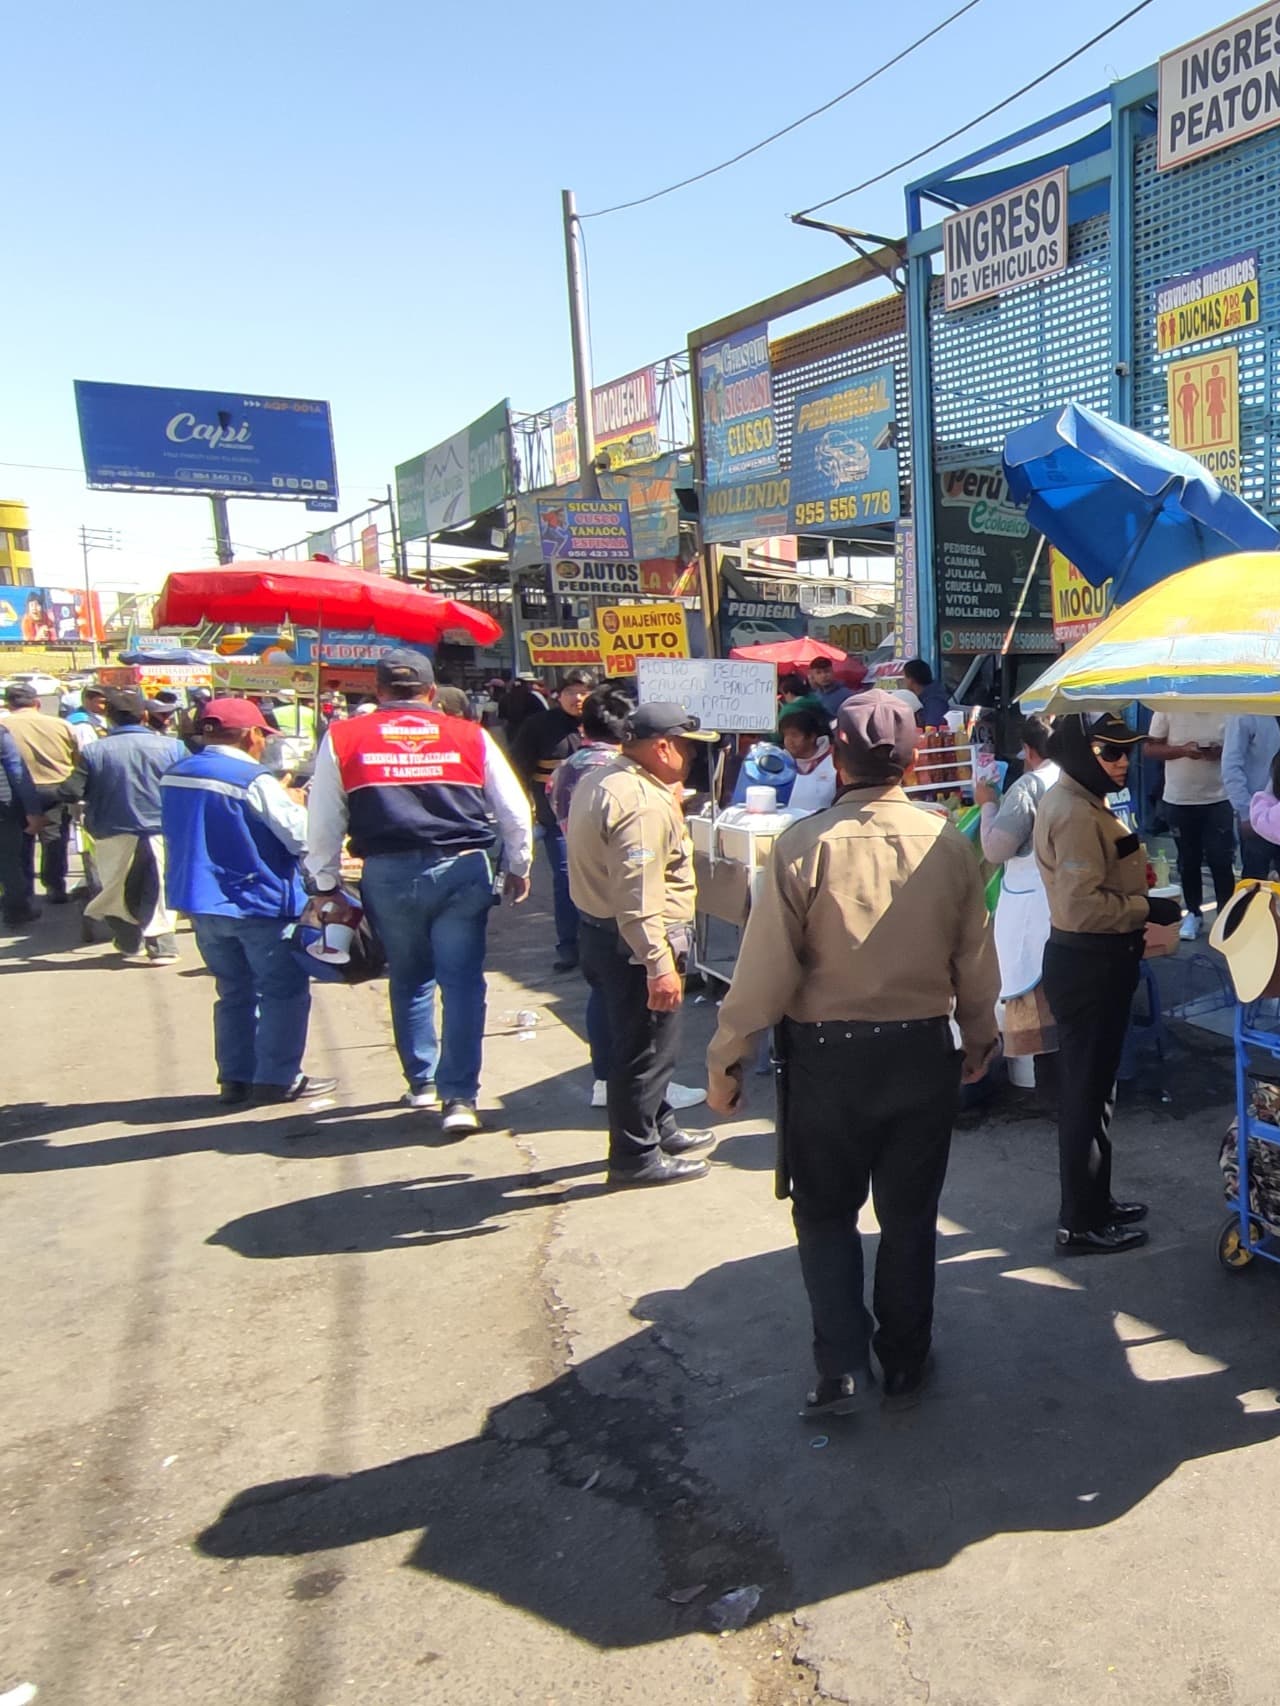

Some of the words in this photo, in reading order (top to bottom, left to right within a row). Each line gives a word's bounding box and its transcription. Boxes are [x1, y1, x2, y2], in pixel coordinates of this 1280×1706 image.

[948, 180, 1062, 272] INGRESO
[950, 277, 969, 301] DE
[974, 240, 1059, 292] VEHICULOS
[1158, 278, 1202, 314] SERVICIOS
[1202, 258, 1256, 297] HIGIENICOS
[1179, 298, 1222, 341] DUCHAS
[593, 375, 649, 436] MOQUEGUA
[797, 377, 890, 433] PEDREGAL
[166, 412, 253, 449] Capi
[727, 415, 773, 457] CUSCO
[706, 478, 791, 517] MOLLENDO
[568, 502, 623, 513] SICUANI
[795, 501, 825, 525] 955
[829, 495, 857, 521] 556
[862, 490, 891, 516] 778
[575, 514, 619, 525] CUSCO
[570, 526, 627, 536] YANAOCA
[610, 550, 630, 558] 333
[943, 542, 986, 556] PEDREGAL
[583, 562, 638, 581] AUTOS
[944, 569, 987, 580] JULIACA
[558, 580, 639, 594] PEDREGAL
[973, 583, 983, 593] LA
[946, 595, 979, 605] VITOR
[1059, 585, 1104, 618] MOQU
[728, 602, 797, 619] PEDREGAL
[945, 607, 1000, 618] MOLLENDO
[622, 611, 682, 628] MAJEÑITOS
[551, 632, 600, 647] AUTOS
[612, 632, 679, 650] AUTO
[713, 662, 759, 679] PECHO
